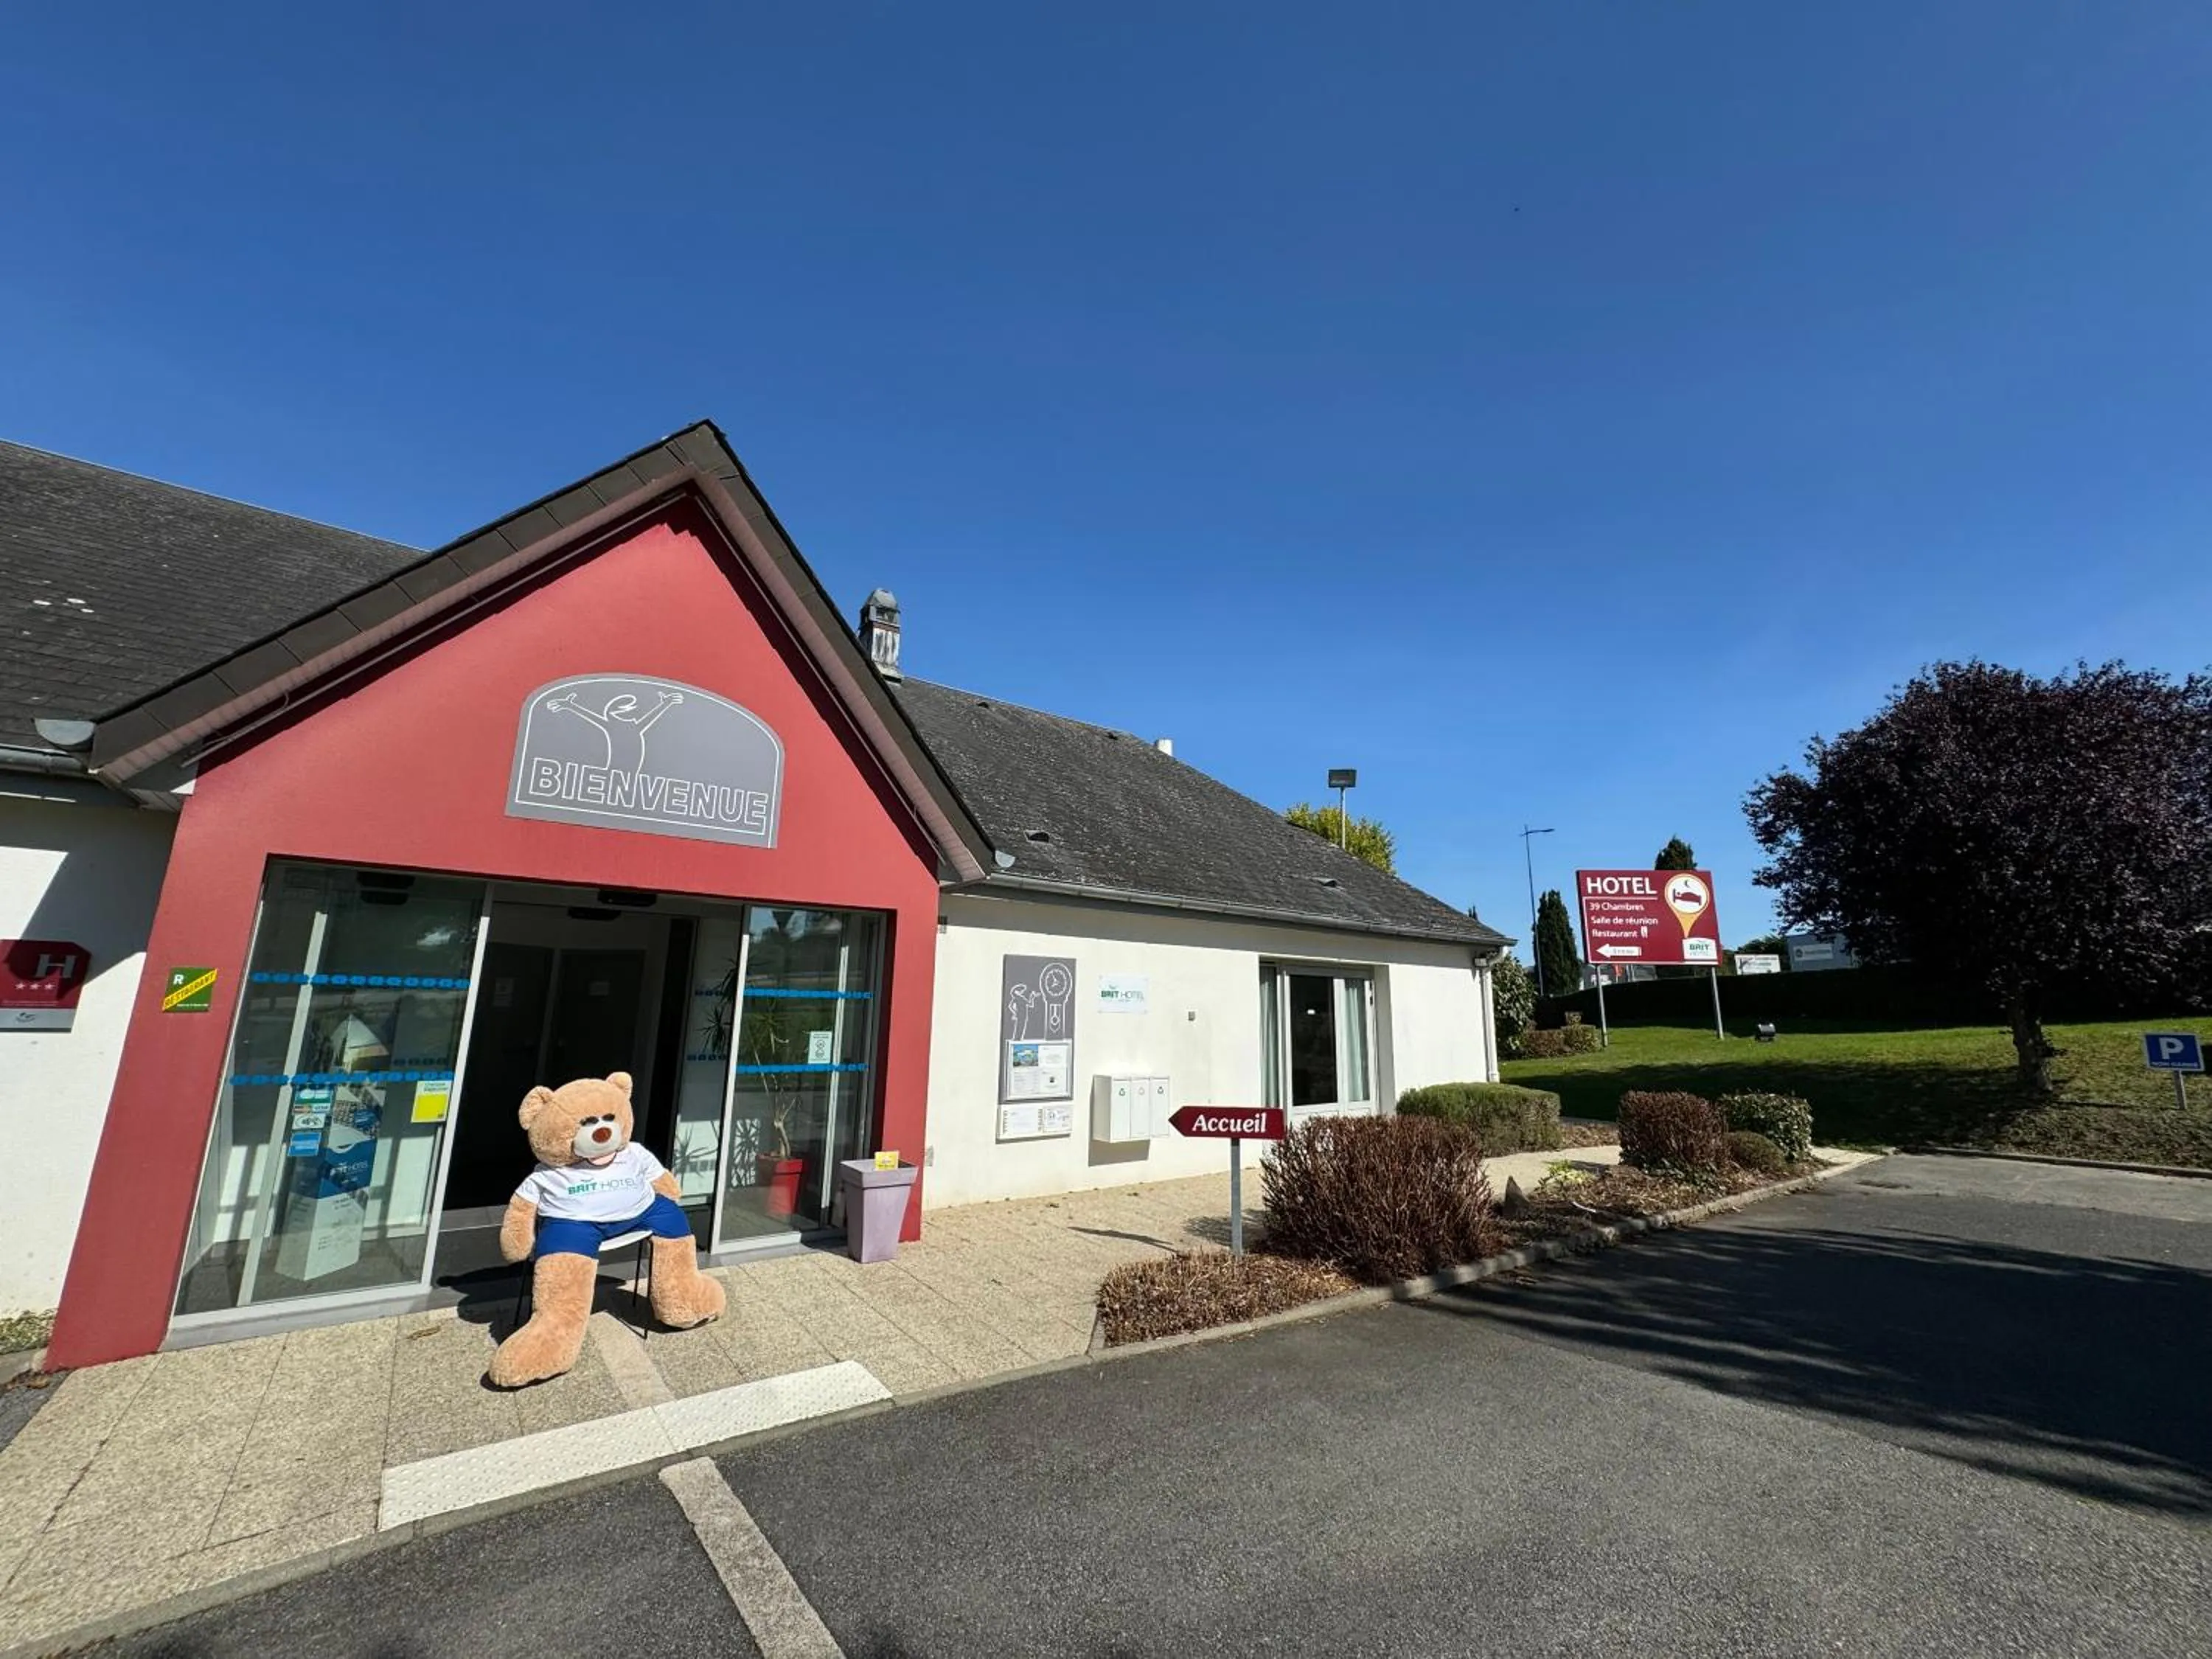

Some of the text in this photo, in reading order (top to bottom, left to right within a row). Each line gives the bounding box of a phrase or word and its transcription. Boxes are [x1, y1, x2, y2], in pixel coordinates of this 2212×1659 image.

[529, 757, 769, 826] BIENVENUE
[1586, 877, 1658, 894] HOTEL
[1589, 902, 1644, 911] 39 Chambres
[1613, 916, 1624, 925] de
[1625, 916, 1658, 925] réunion
[1592, 929, 1638, 938] Restaurant
[35, 953, 77, 978] H
[173, 974, 184, 985] R
[1101, 990, 1119, 998] BRIT
[2159, 1037, 2184, 1060] P
[1192, 1112, 1267, 1133] Accueil
[567, 1182, 597, 1195] BRIT
[601, 1178, 637, 1189] HOTEL
